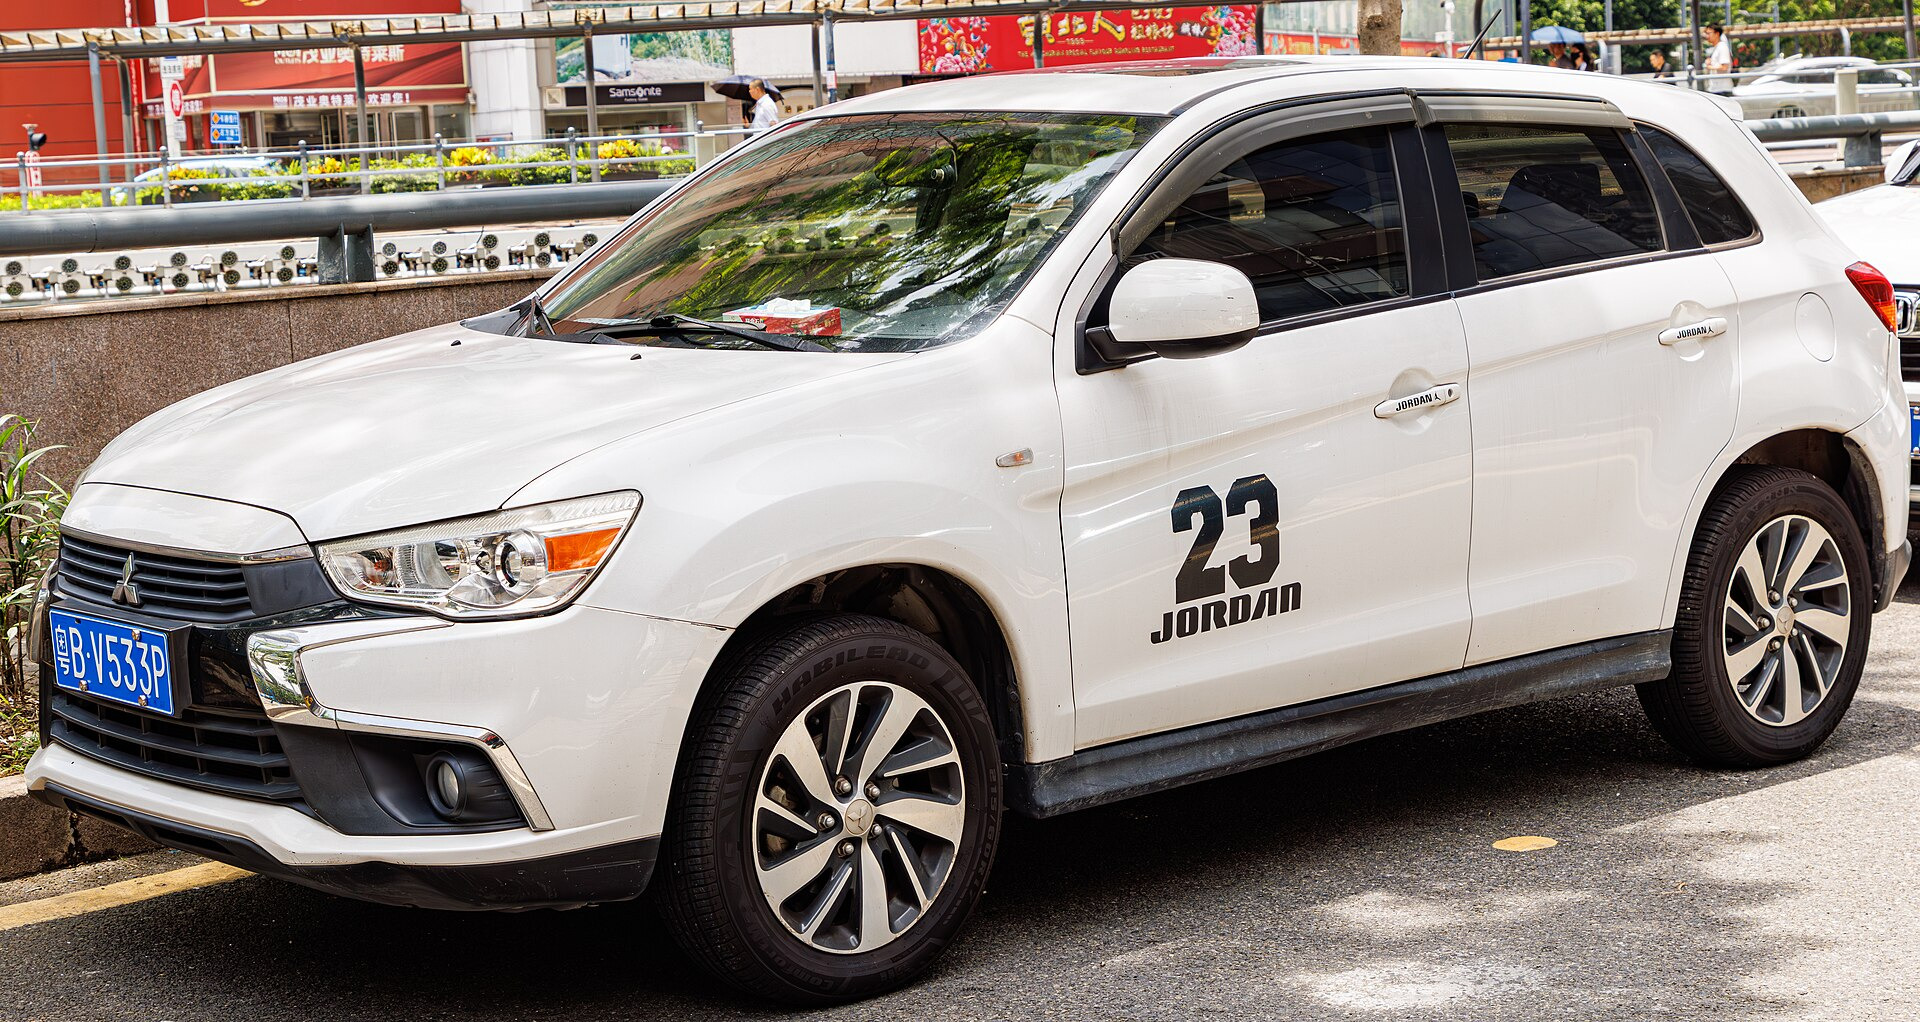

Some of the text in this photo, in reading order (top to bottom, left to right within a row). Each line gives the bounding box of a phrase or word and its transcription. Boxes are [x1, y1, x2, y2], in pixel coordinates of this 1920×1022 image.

[609, 86, 662, 98] Samsonite
[1677, 326, 1707, 339] JORDAN
[1396, 393, 1433, 412] JORDAN
[1170, 473, 1280, 604] 23
[1150, 581, 1302, 645] JORDAN
[771, 645, 931, 715] HABILEAD
